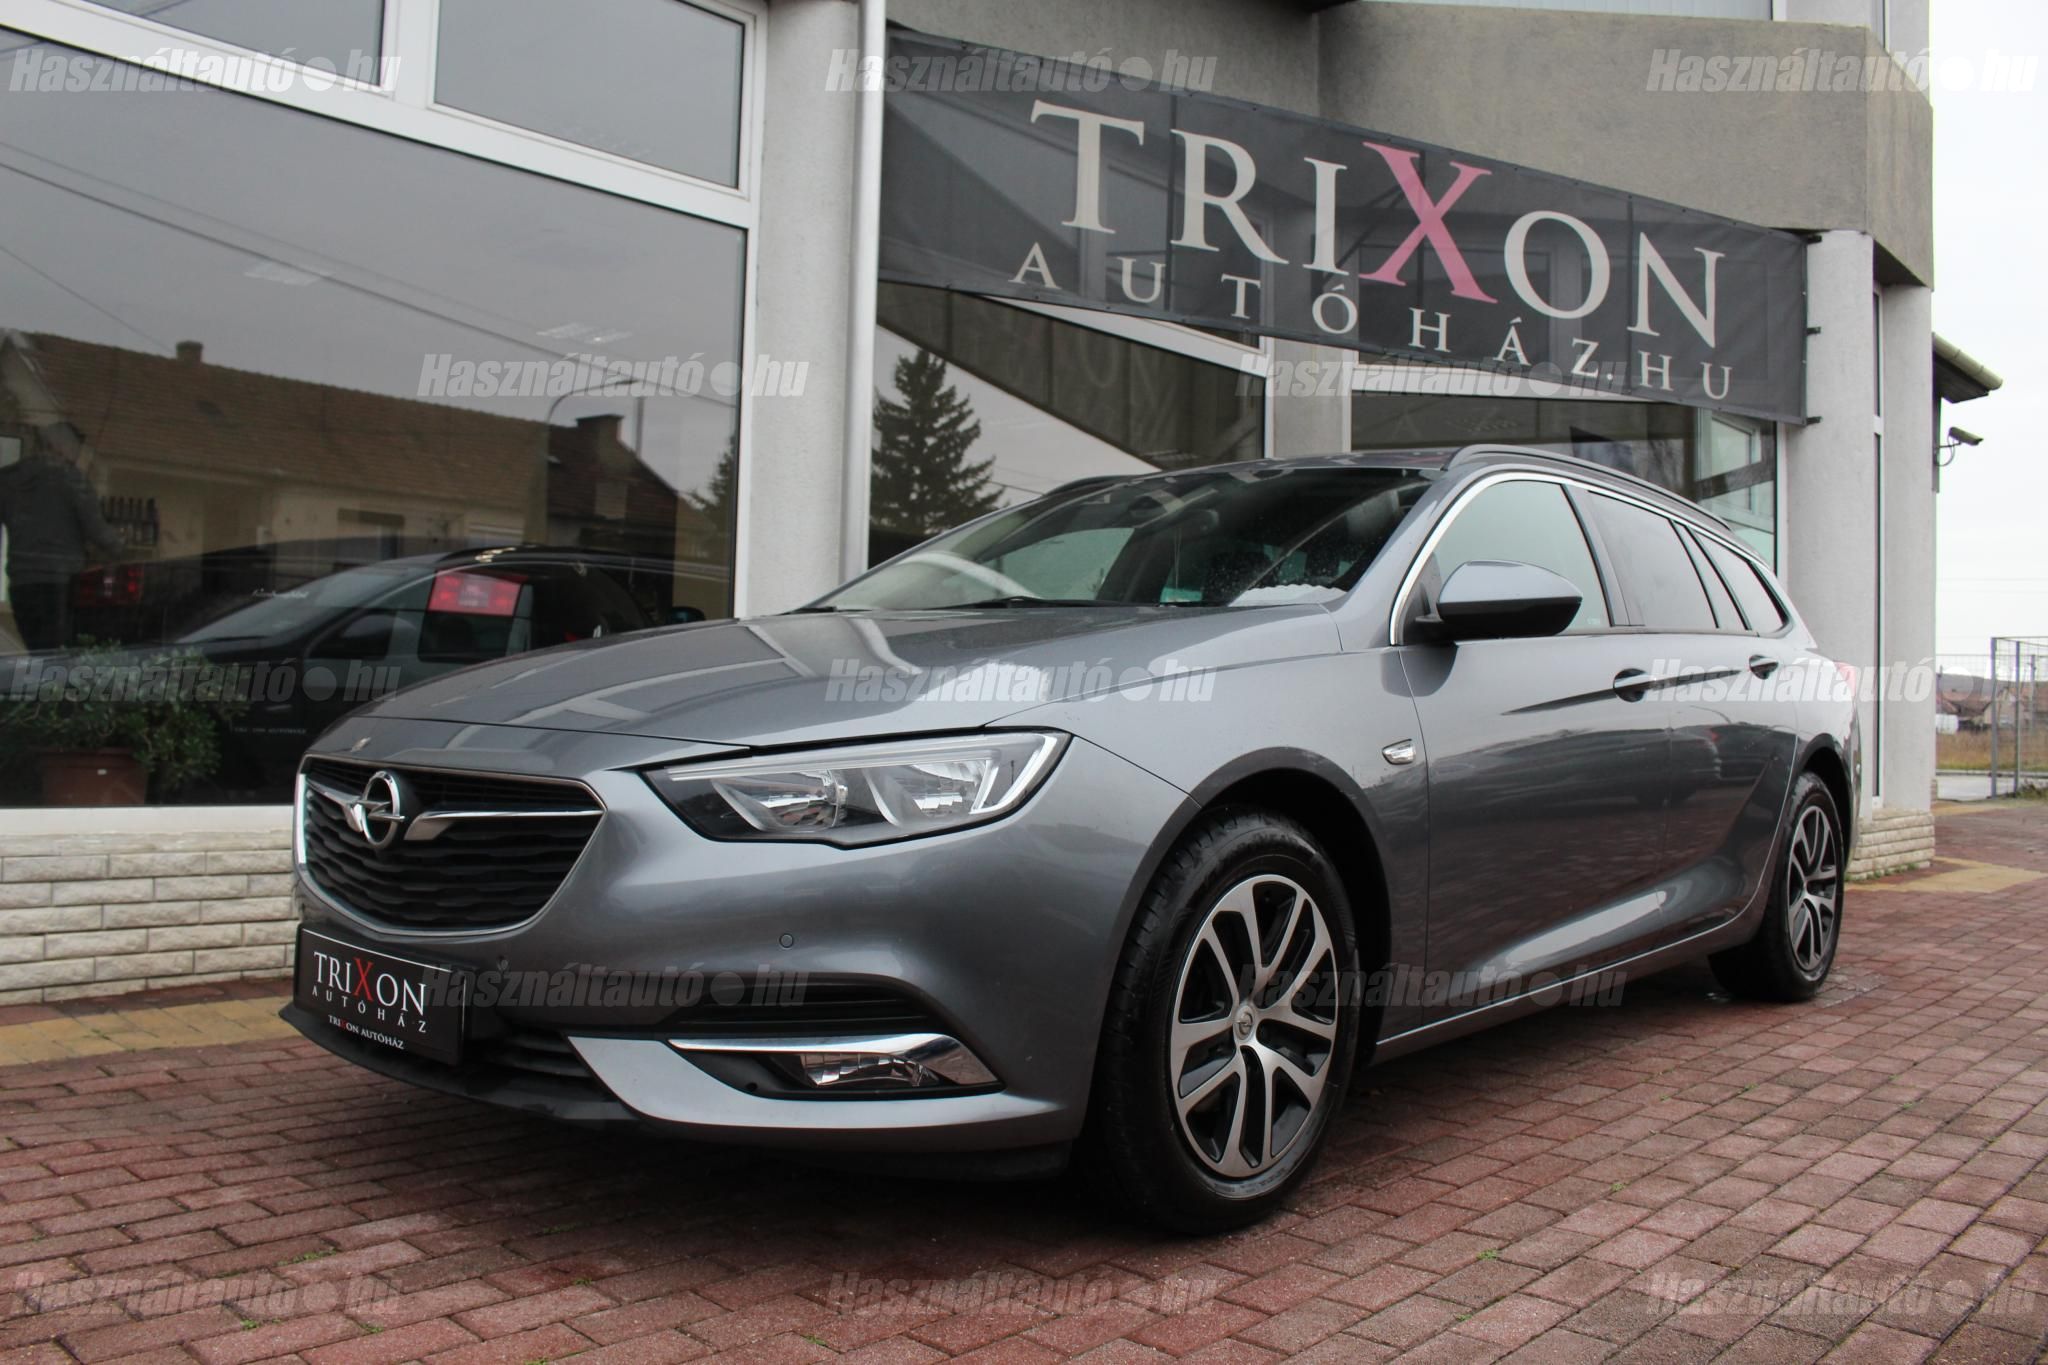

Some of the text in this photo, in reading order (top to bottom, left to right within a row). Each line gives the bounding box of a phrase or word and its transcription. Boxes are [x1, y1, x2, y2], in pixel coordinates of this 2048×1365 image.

[1030, 99, 1725, 349] TRIXON
[311, 985, 427, 1033] AUTÓHÁZ
[313, 951, 427, 1016] TRIXON
[328, 1014, 405, 1050] TRIXON AUTÓHÁZ
